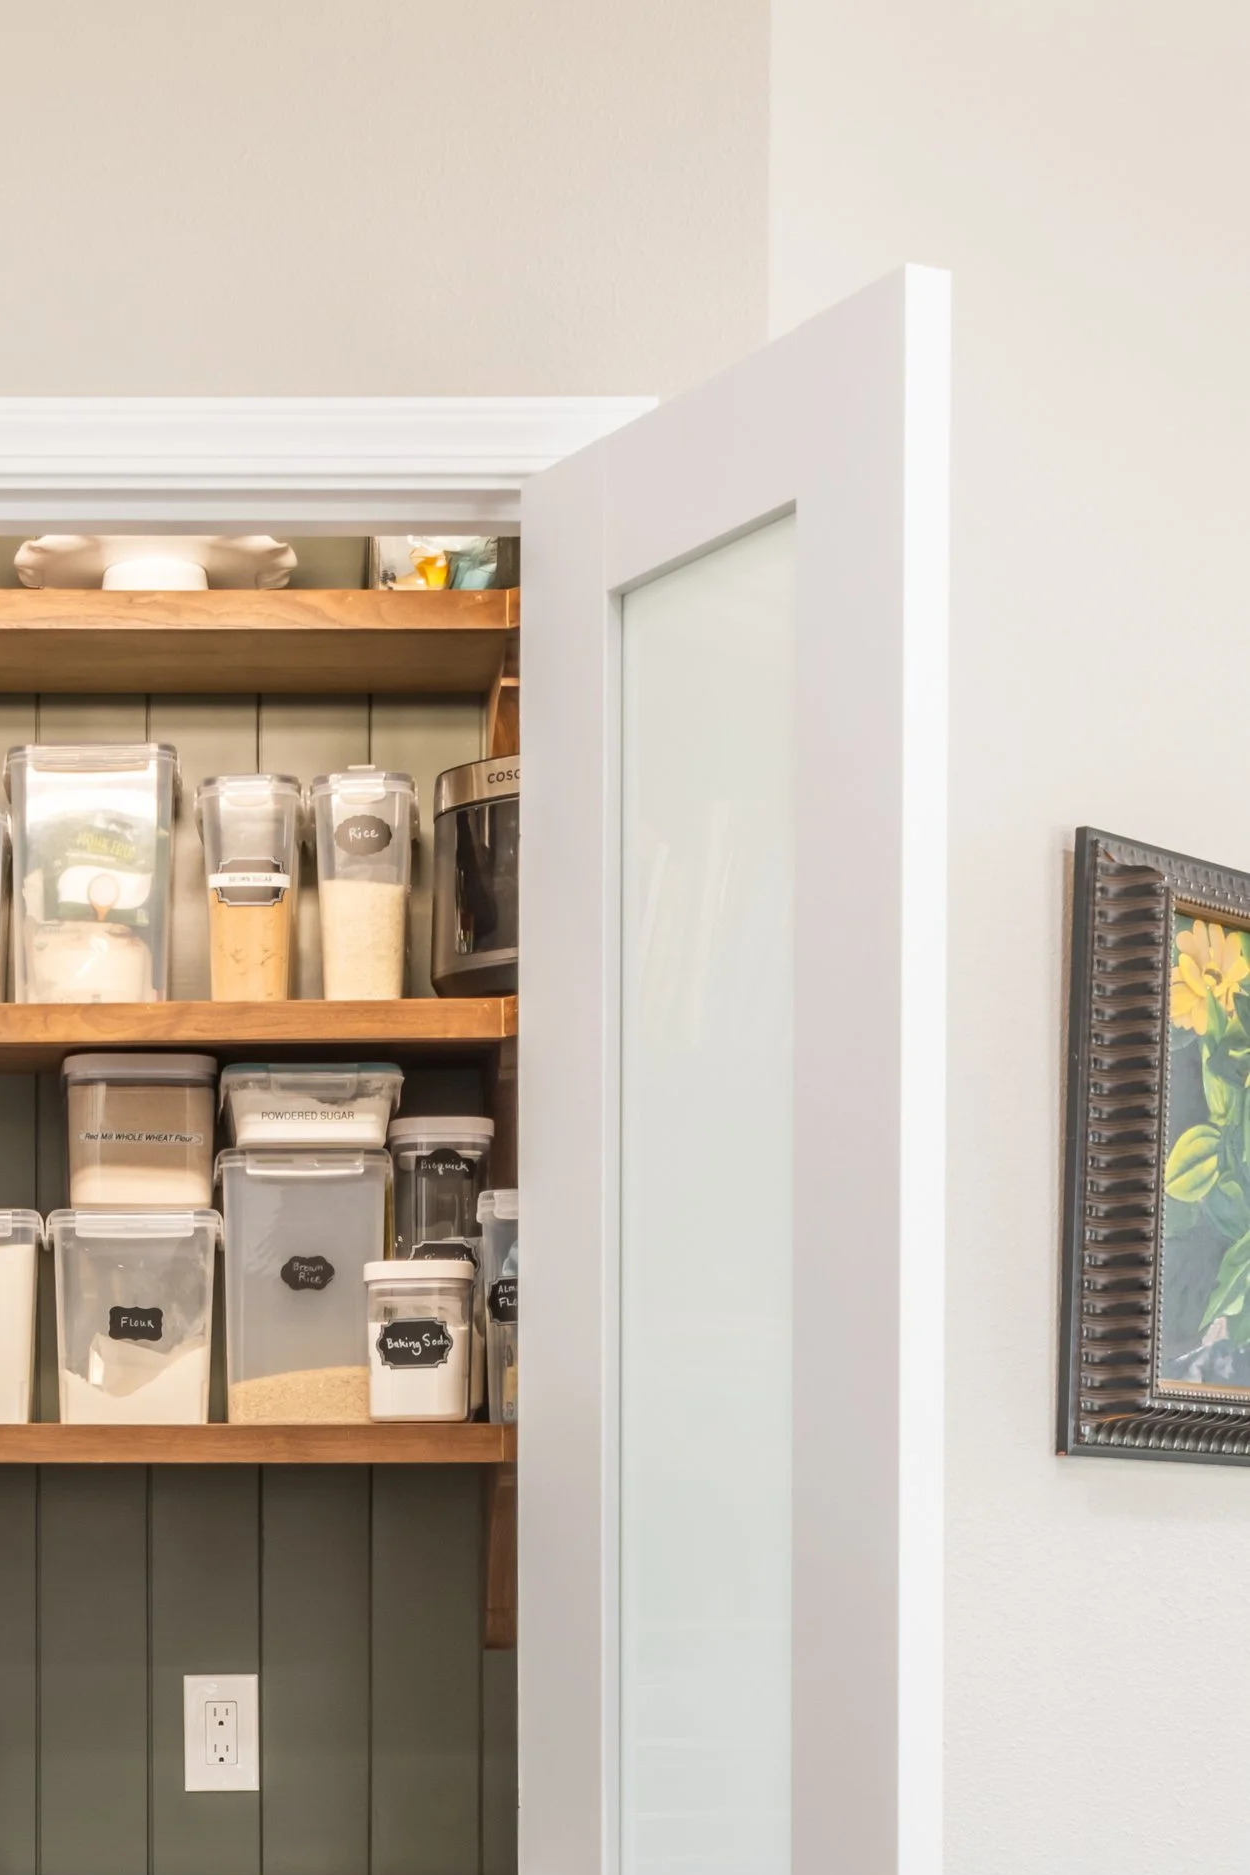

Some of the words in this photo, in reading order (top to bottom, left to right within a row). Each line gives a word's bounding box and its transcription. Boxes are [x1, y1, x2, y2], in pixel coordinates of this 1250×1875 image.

[487, 768, 521, 785] COSO
[348, 826, 380, 840] Rice
[261, 1110, 318, 1121] POWDERED
[320, 1110, 355, 1121] SUGAR
[115, 1133, 144, 1142] WHOLE
[145, 1134, 174, 1142] WHEAT
[298, 1271, 323, 1284] Rice
[386, 1336, 422, 1356] Baking
[422, 1333, 451, 1347] Soda
